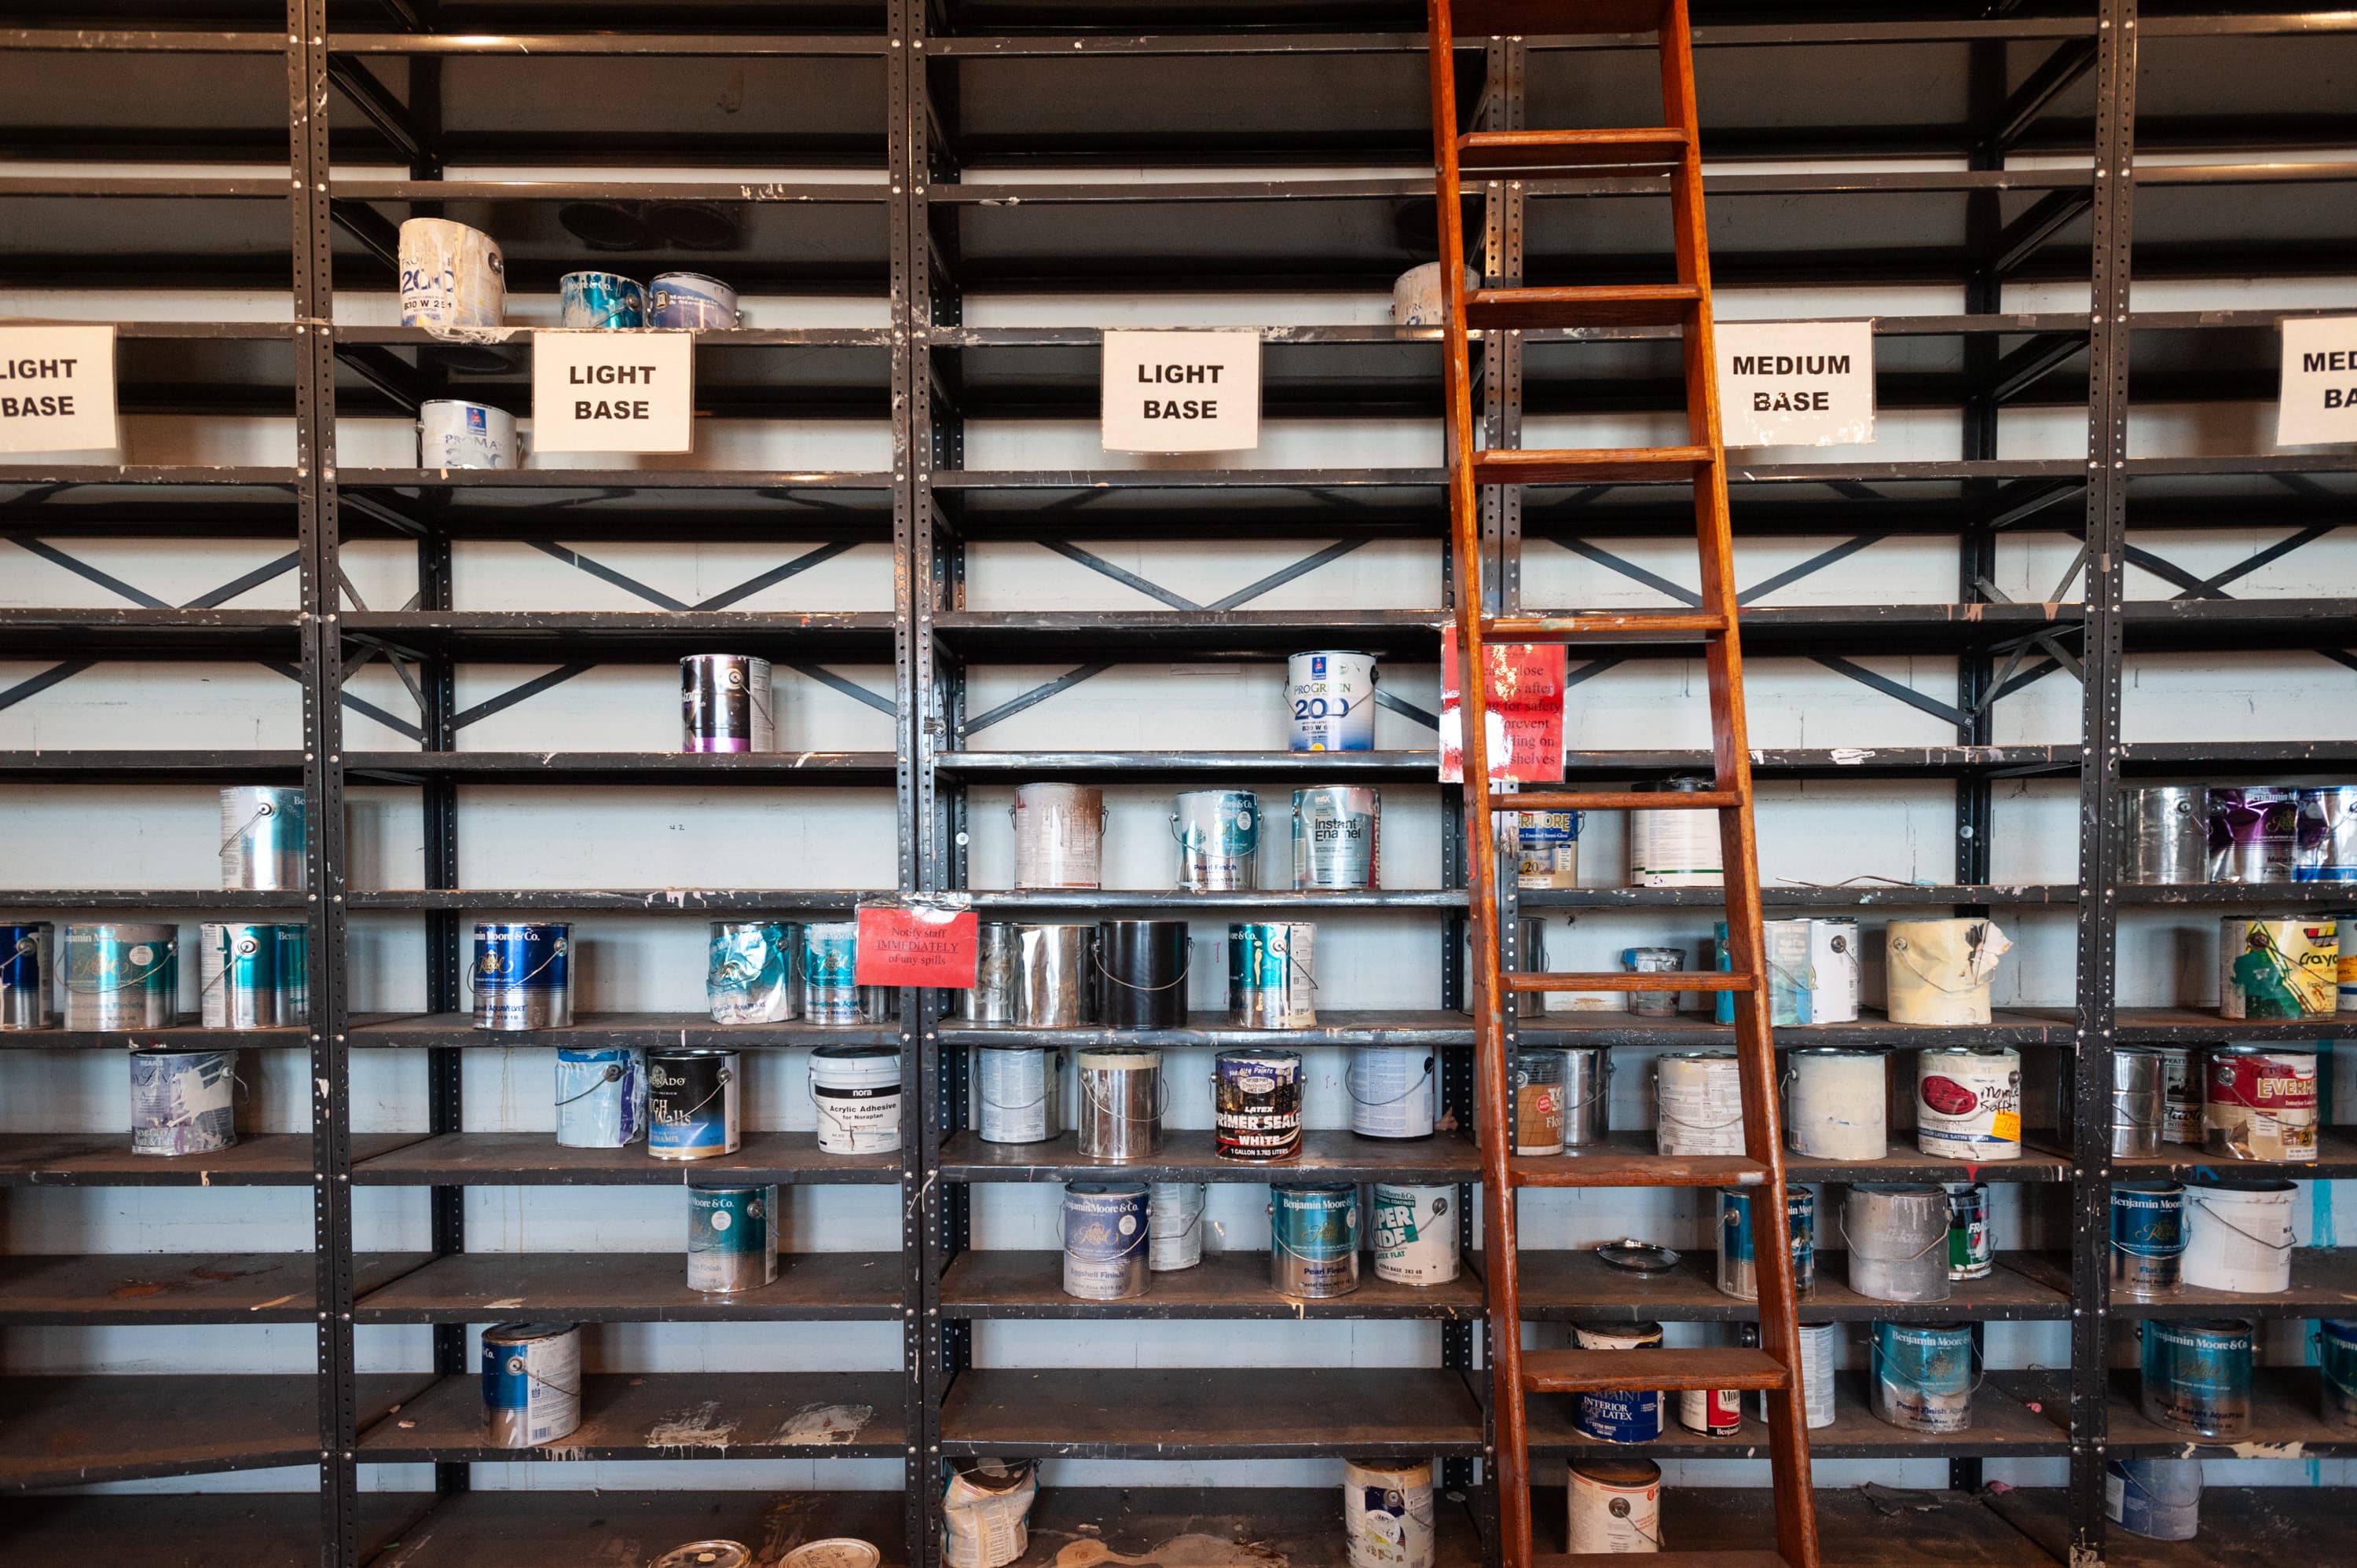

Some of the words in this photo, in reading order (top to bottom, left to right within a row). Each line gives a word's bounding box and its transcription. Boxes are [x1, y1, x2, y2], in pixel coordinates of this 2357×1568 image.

[1733, 355, 1850, 375] MEDIUM
[570, 365, 656, 384] LIGHT
[1138, 365, 1224, 383] LIGHT
[2, 396, 75, 417] BASE
[1754, 391, 1829, 411] BASE
[575, 401, 649, 419] BASE
[1144, 400, 1218, 419] BASE
[1525, 683, 1554, 694] after
[1504, 700, 1521, 711] for
[1525, 700, 1560, 713] safety
[1505, 720, 1549, 731] prevent
[1540, 738, 1554, 746] on
[1511, 753, 1556, 765] shelves
[1315, 819, 1357, 830] Instant
[1524, 861, 1538, 873] 20
[515, 930, 524, 940] &
[524, 930, 541, 941] Co.
[892, 927, 922, 939] Notify
[924, 929, 947, 938] staff
[877, 940, 959, 951] IMMEDIATELY
[889, 954, 900, 963] of
[902, 957, 918, 967] any
[921, 955, 946, 966] spills
[860, 1102, 896, 1112] Adhesive
[654, 1109, 691, 1127] Walls
[1217, 1112, 1259, 1130] RIMER
[1263, 1112, 1302, 1130] SEALE
[1239, 1136, 1281, 1146] WHITE
[2301, 1131, 2311, 1144] 20
[691, 1196, 711, 1207] Moore
[720, 1199, 735, 1207] Co.
[1283, 1198, 1321, 1211] Benjamin
[1322, 1200, 1346, 1210] Moore
[2110, 1196, 2158, 1209] Benjamin
[1091, 1203, 1118, 1213] Moore
[1119, 1203, 1127, 1212] &
[1127, 1203, 1139, 1211] Co.
[1376, 1206, 1413, 1229] PER
[1376, 1227, 1406, 1247] IDE
[1071, 1267, 1098, 1278] Eggshell
[1304, 1267, 1325, 1276] Pearl
[1892, 1330, 1936, 1346] Benjamin
[1937, 1337, 1962, 1346] Moore
[2196, 1338, 2229, 1350] Moore
[2230, 1340, 2238, 1350] &
[1584, 1396, 1628, 1412] INTERIOR
[1897, 1401, 1919, 1411] Pearl
[1603, 1409, 1633, 1420] LATEX
